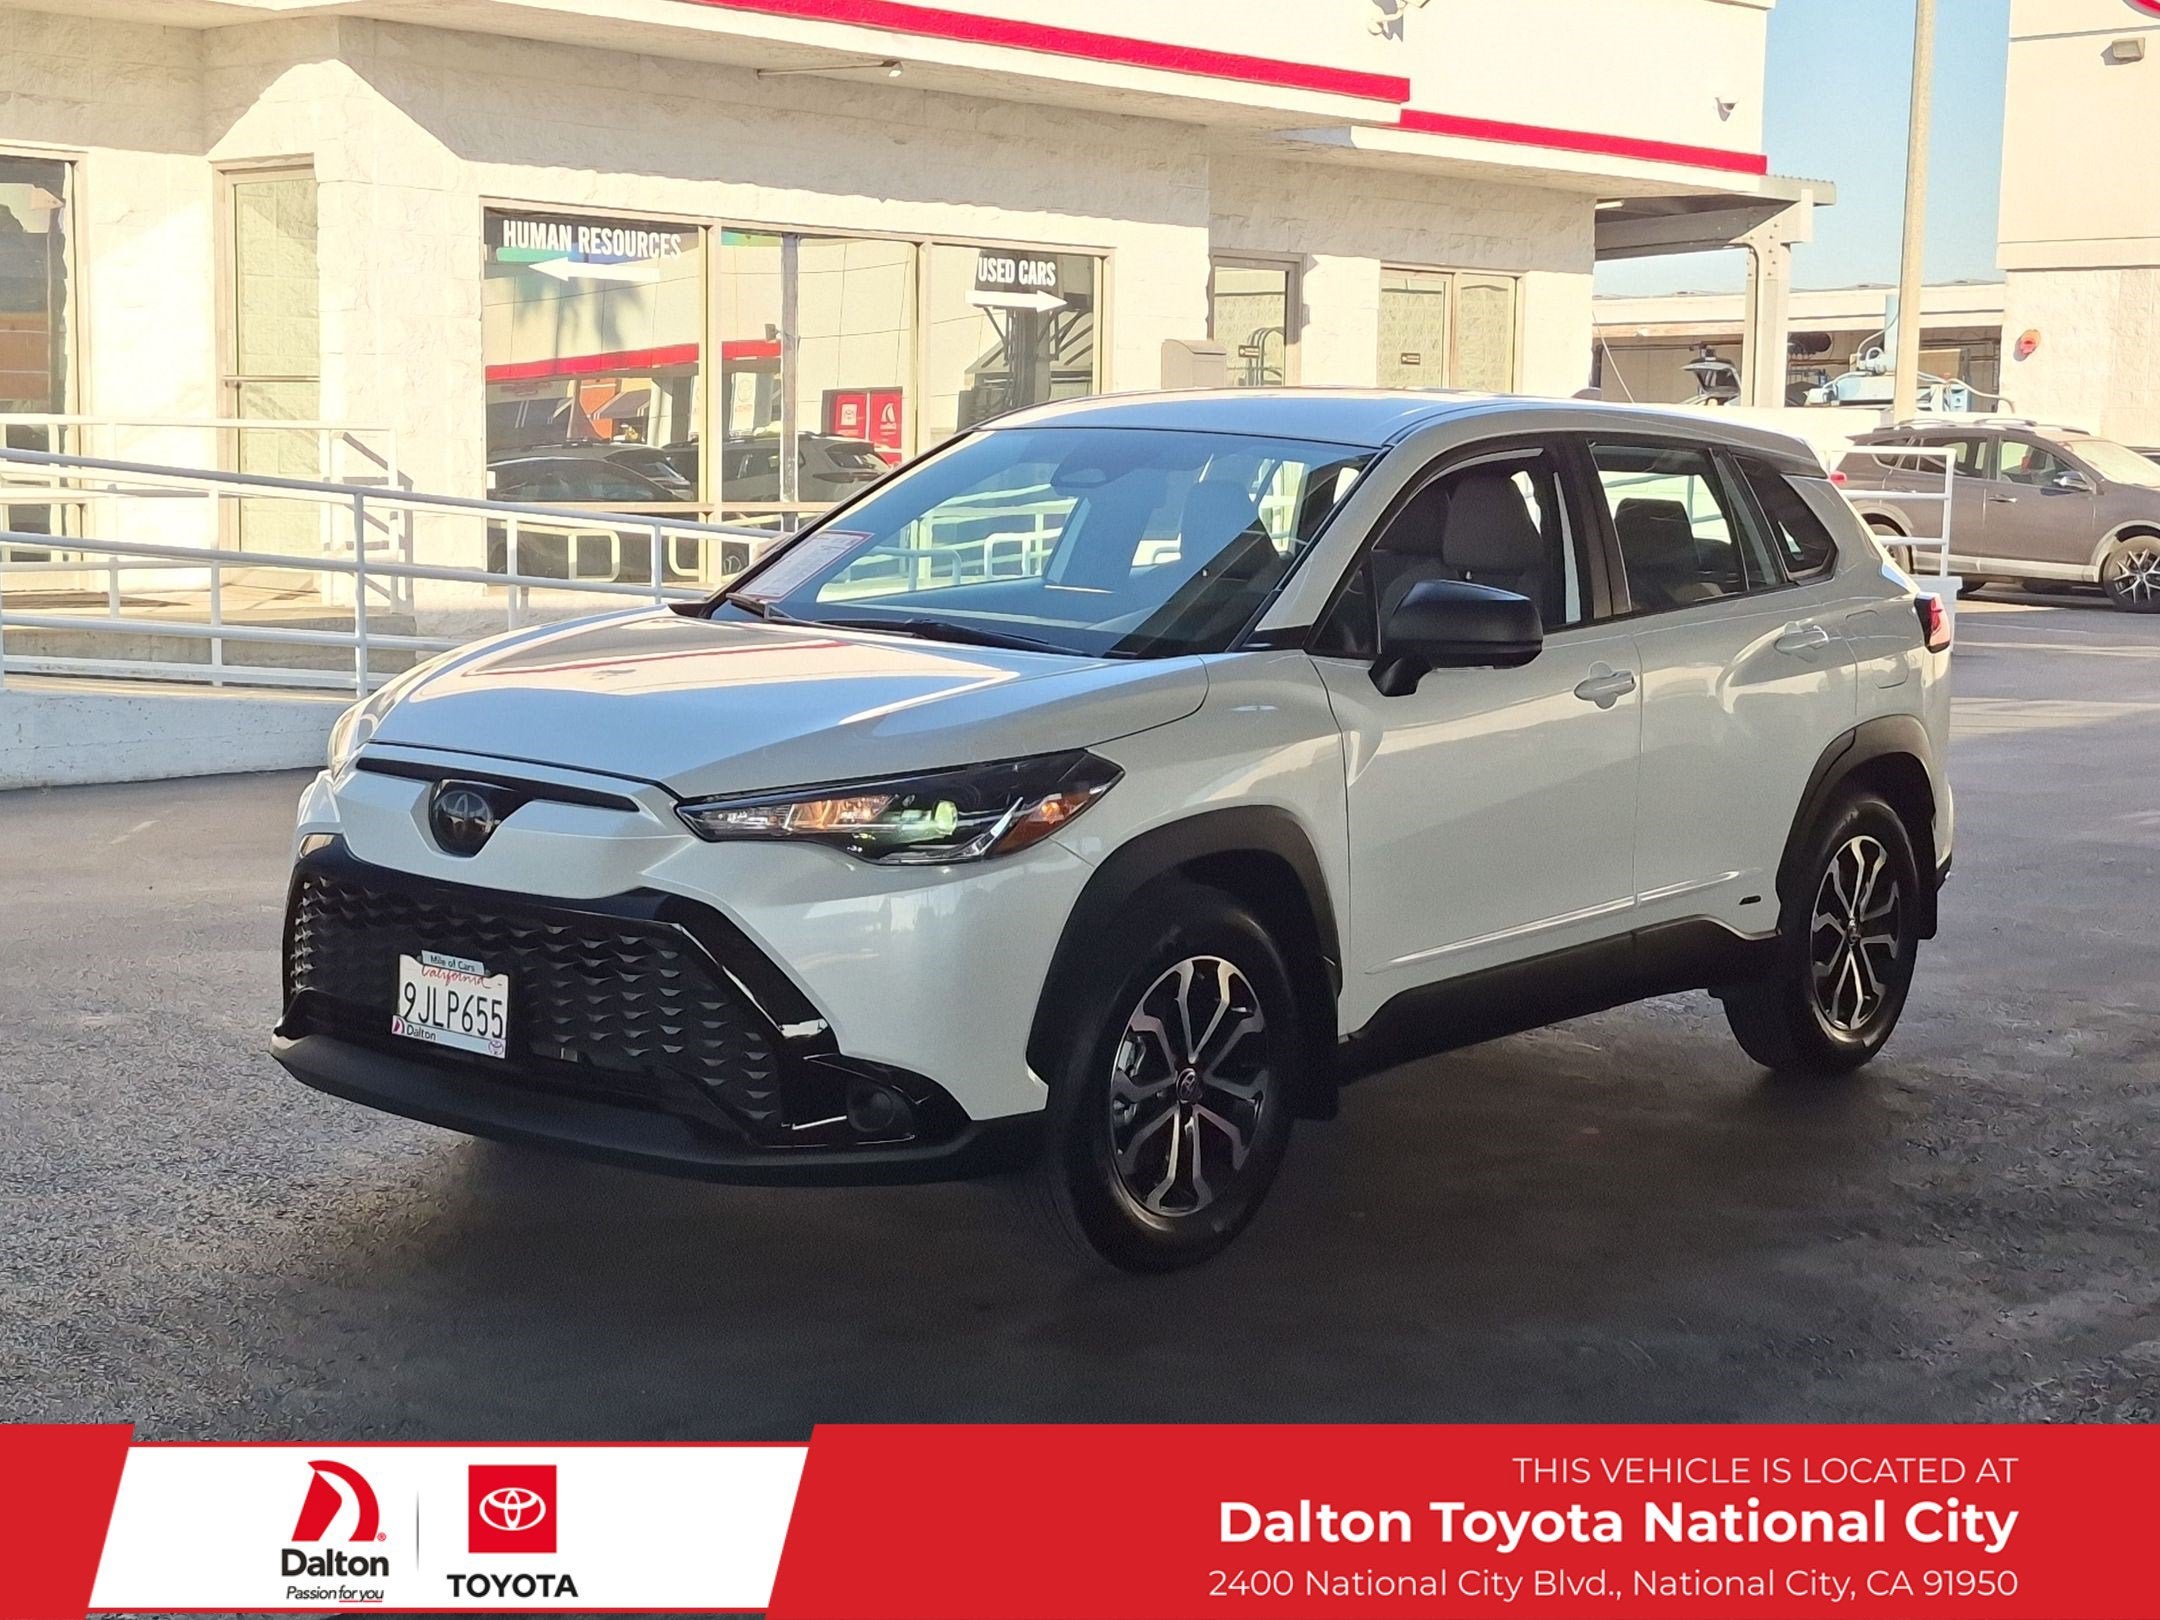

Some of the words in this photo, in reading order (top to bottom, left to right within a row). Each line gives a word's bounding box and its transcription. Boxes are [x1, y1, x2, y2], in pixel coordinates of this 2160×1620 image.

[503, 219, 572, 252] HUMAN
[578, 226, 682, 260] RESOURCES
[977, 256, 1016, 284] USED
[1018, 259, 1057, 287] CARS
[421, 964, 491, 989] California
[430, 954, 446, 965] Mile
[448, 956, 456, 968] of
[458, 961, 476, 972] Cars
[404, 981, 503, 1039] 9JLP655
[406, 1024, 437, 1041] Dalton
